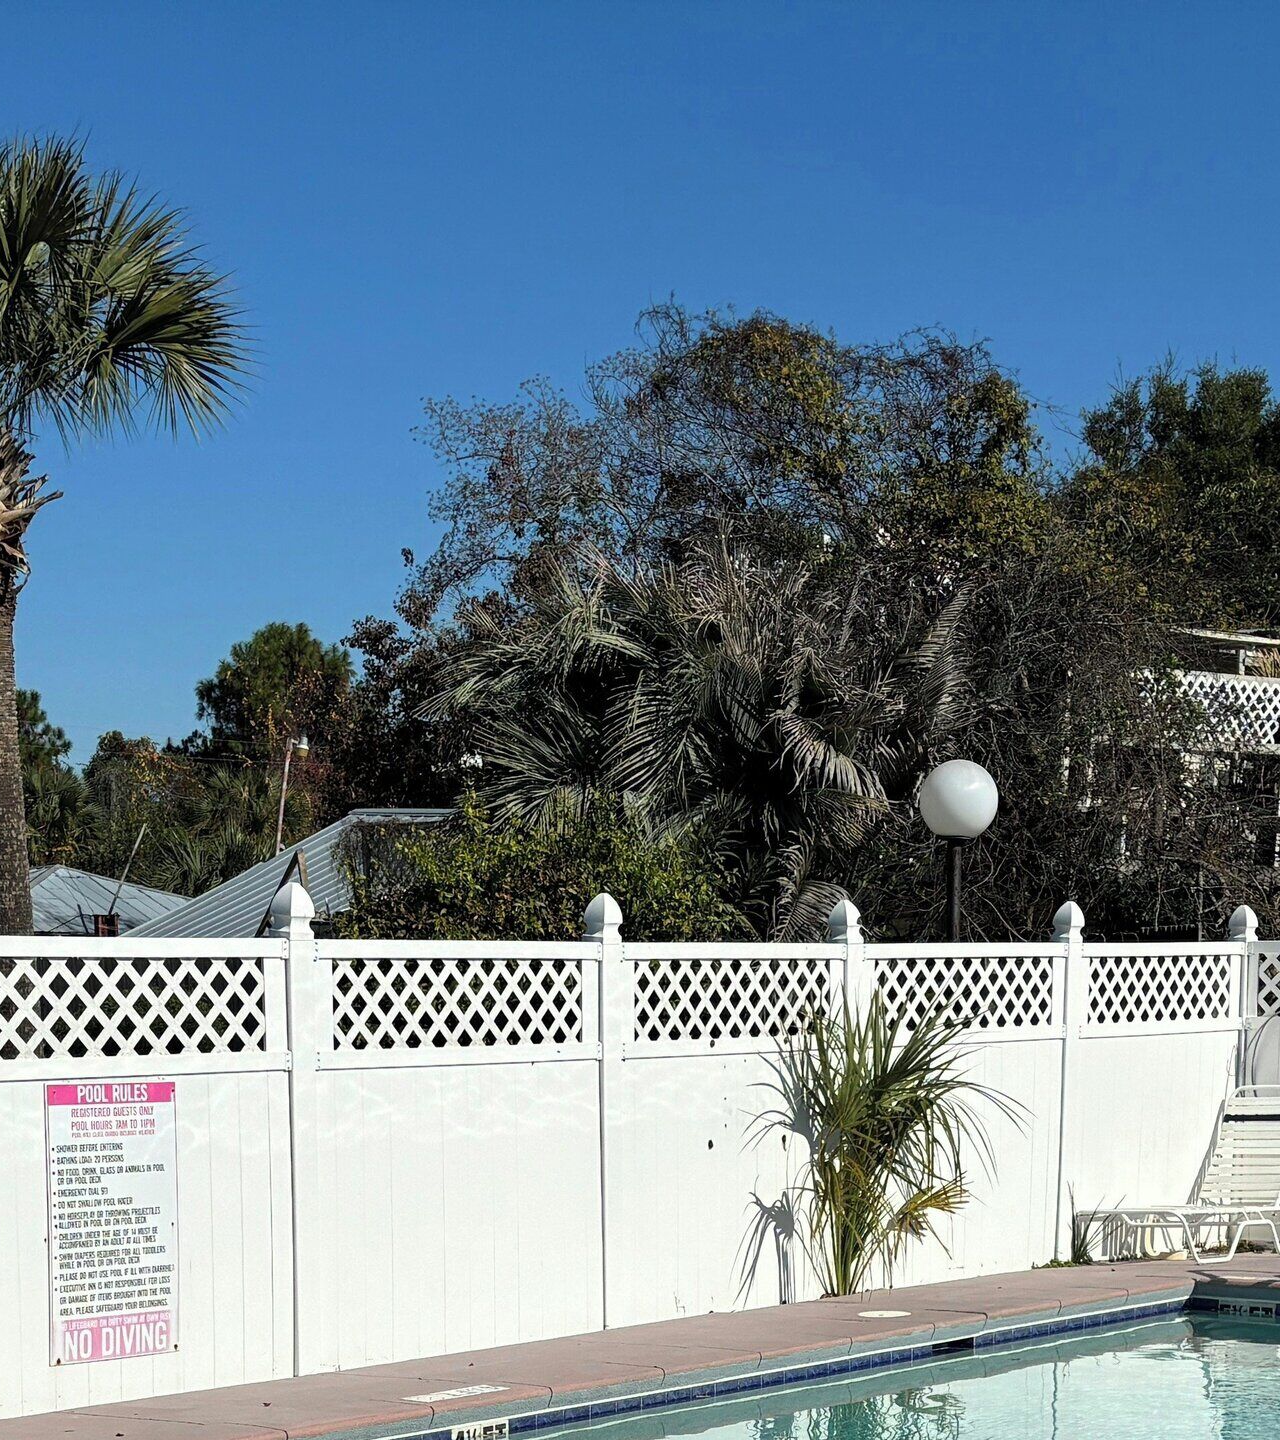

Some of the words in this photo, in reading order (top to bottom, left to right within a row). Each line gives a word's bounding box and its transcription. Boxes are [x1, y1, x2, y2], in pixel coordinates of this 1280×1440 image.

[77, 1085, 108, 1103] POOL
[113, 1084, 148, 1101] RULES
[71, 1107, 110, 1118] REGISTERED
[113, 1106, 137, 1116] GUESTS
[139, 1106, 154, 1115] ONLY
[71, 1122, 88, 1130] POOL
[91, 1120, 112, 1130] HOURS
[116, 1120, 128, 1129] 7AM
[130, 1119, 137, 1128] TO
[57, 1145, 77, 1153] SHOWER
[80, 1144, 98, 1152] BEFORE
[125, 1165, 145, 1173] ANIMALS
[89, 1176, 101, 1184] DECK
[58, 1188, 86, 1197] EMERGENCY
[58, 1201, 65, 1209] DO
[78, 1199, 102, 1207] SWALLOW
[103, 1199, 116, 1207] POOL
[59, 1213, 65, 1221] NO
[67, 1212, 95, 1220] HORSEPLAY
[105, 1210, 130, 1218] THROWING
[132, 1207, 160, 1215] PROJECTILES
[59, 1220, 81, 1229] ALLOWED
[83, 1219, 88, 1227] IN
[90, 1218, 103, 1227] POOL
[105, 1218, 111, 1226] OR
[113, 1217, 119, 1225] ON
[121, 1216, 133, 1224] POOL
[135, 1215, 147, 1224] DECK
[59, 1232, 82, 1241] CHILDREN
[85, 1231, 100, 1239] UNDER
[102, 1230, 111, 1238] THE
[113, 1229, 121, 1238] AGE
[123, 1229, 129, 1237] OF
[59, 1240, 93, 1249] ACCOMPANIED
[95, 1239, 100, 1247] BY
[102, 1239, 109, 1247] AN
[111, 1238, 125, 1246] ADULT
[126, 1237, 131, 1245] AT
[143, 1236, 156, 1244] TIMES
[59, 1253, 73, 1261] SWIM
[75, 1251, 95, 1260] DIAPERS
[97, 1250, 120, 1258] REQUIRED
[122, 1249, 131, 1257] FOR
[143, 1246, 165, 1255] TODDLERS
[59, 1261, 74, 1269] WHILE
[83, 1260, 96, 1268] POOL
[98, 1259, 104, 1267] OR
[115, 1258, 127, 1266] POOL
[59, 1273, 78, 1281] PLEASE
[80, 1272, 86, 1280] DO
[88, 1271, 97, 1279] NOT
[99, 1270, 108, 1278] USE
[139, 1267, 151, 1275] WITH
[60, 1283, 86, 1293] EXECUTIVE
[88, 1283, 96, 1291] INN
[104, 1282, 113, 1290] NOT
[115, 1279, 146, 1288] RESPONSIBLE
[148, 1278, 157, 1286] FOR
[159, 1276, 170, 1285] LOSS
[60, 1297, 67, 1305] OR
[69, 1295, 88, 1303] DAMAGE
[90, 1294, 95, 1302] OF
[98, 1293, 112, 1301] ITEMS
[114, 1291, 136, 1300] BROUGHT
[137, 1290, 148, 1298] INTO
[150, 1289, 158, 1297] THE
[160, 1287, 171, 1296] POOL
[76, 1306, 94, 1314] PLEASE
[96, 1303, 123, 1313] SAFEGUARD
[125, 1302, 137, 1310] YOUR
[70, 1321, 98, 1330] LIFEGUARD
[147, 1314, 158, 1322] OWN
[65, 1330, 92, 1360] NO
[102, 1322, 167, 1357] DIVING
